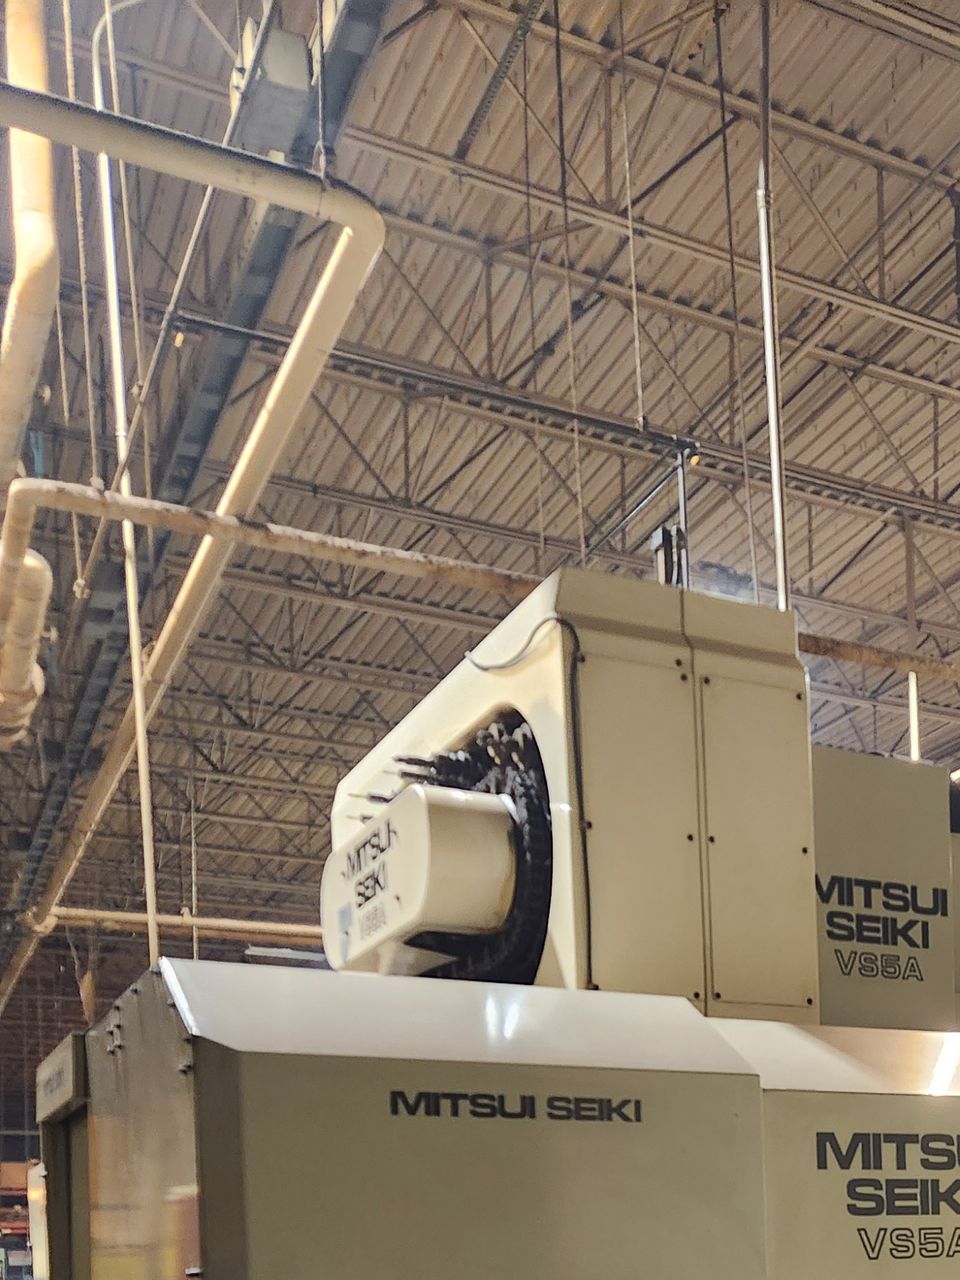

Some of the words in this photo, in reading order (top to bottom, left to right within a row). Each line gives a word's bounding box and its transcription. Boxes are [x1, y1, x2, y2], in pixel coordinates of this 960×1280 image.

[815, 873, 949, 917] MITSUI
[826, 910, 930, 949] SEIKI
[834, 948, 924, 982] VS5A
[389, 1090, 537, 1120] MITSUI
[546, 1095, 643, 1123] SEIKI
